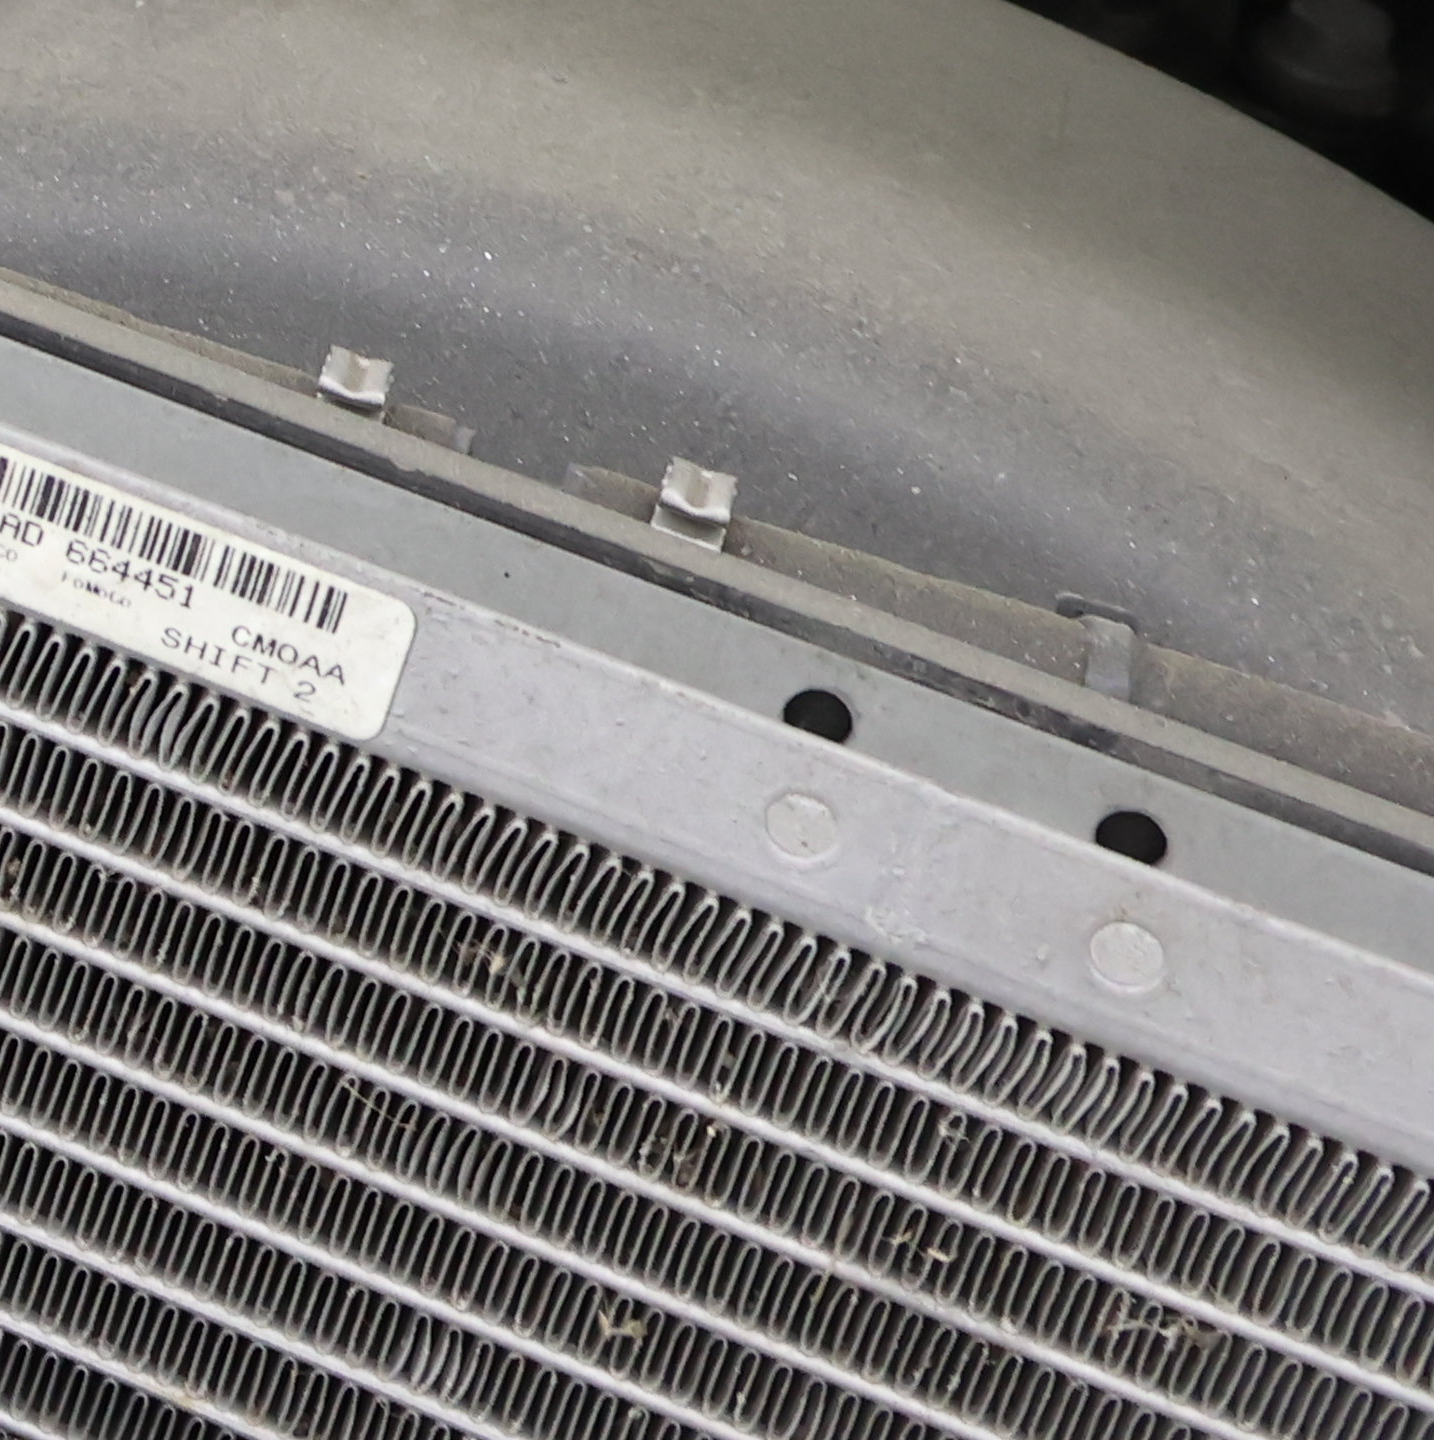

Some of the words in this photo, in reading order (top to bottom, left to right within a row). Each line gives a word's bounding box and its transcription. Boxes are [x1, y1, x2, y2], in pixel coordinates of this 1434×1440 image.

[65, 539, 196, 610] 664451
[161, 627, 278, 685] SHIFT
[293, 681, 316, 703] 2
